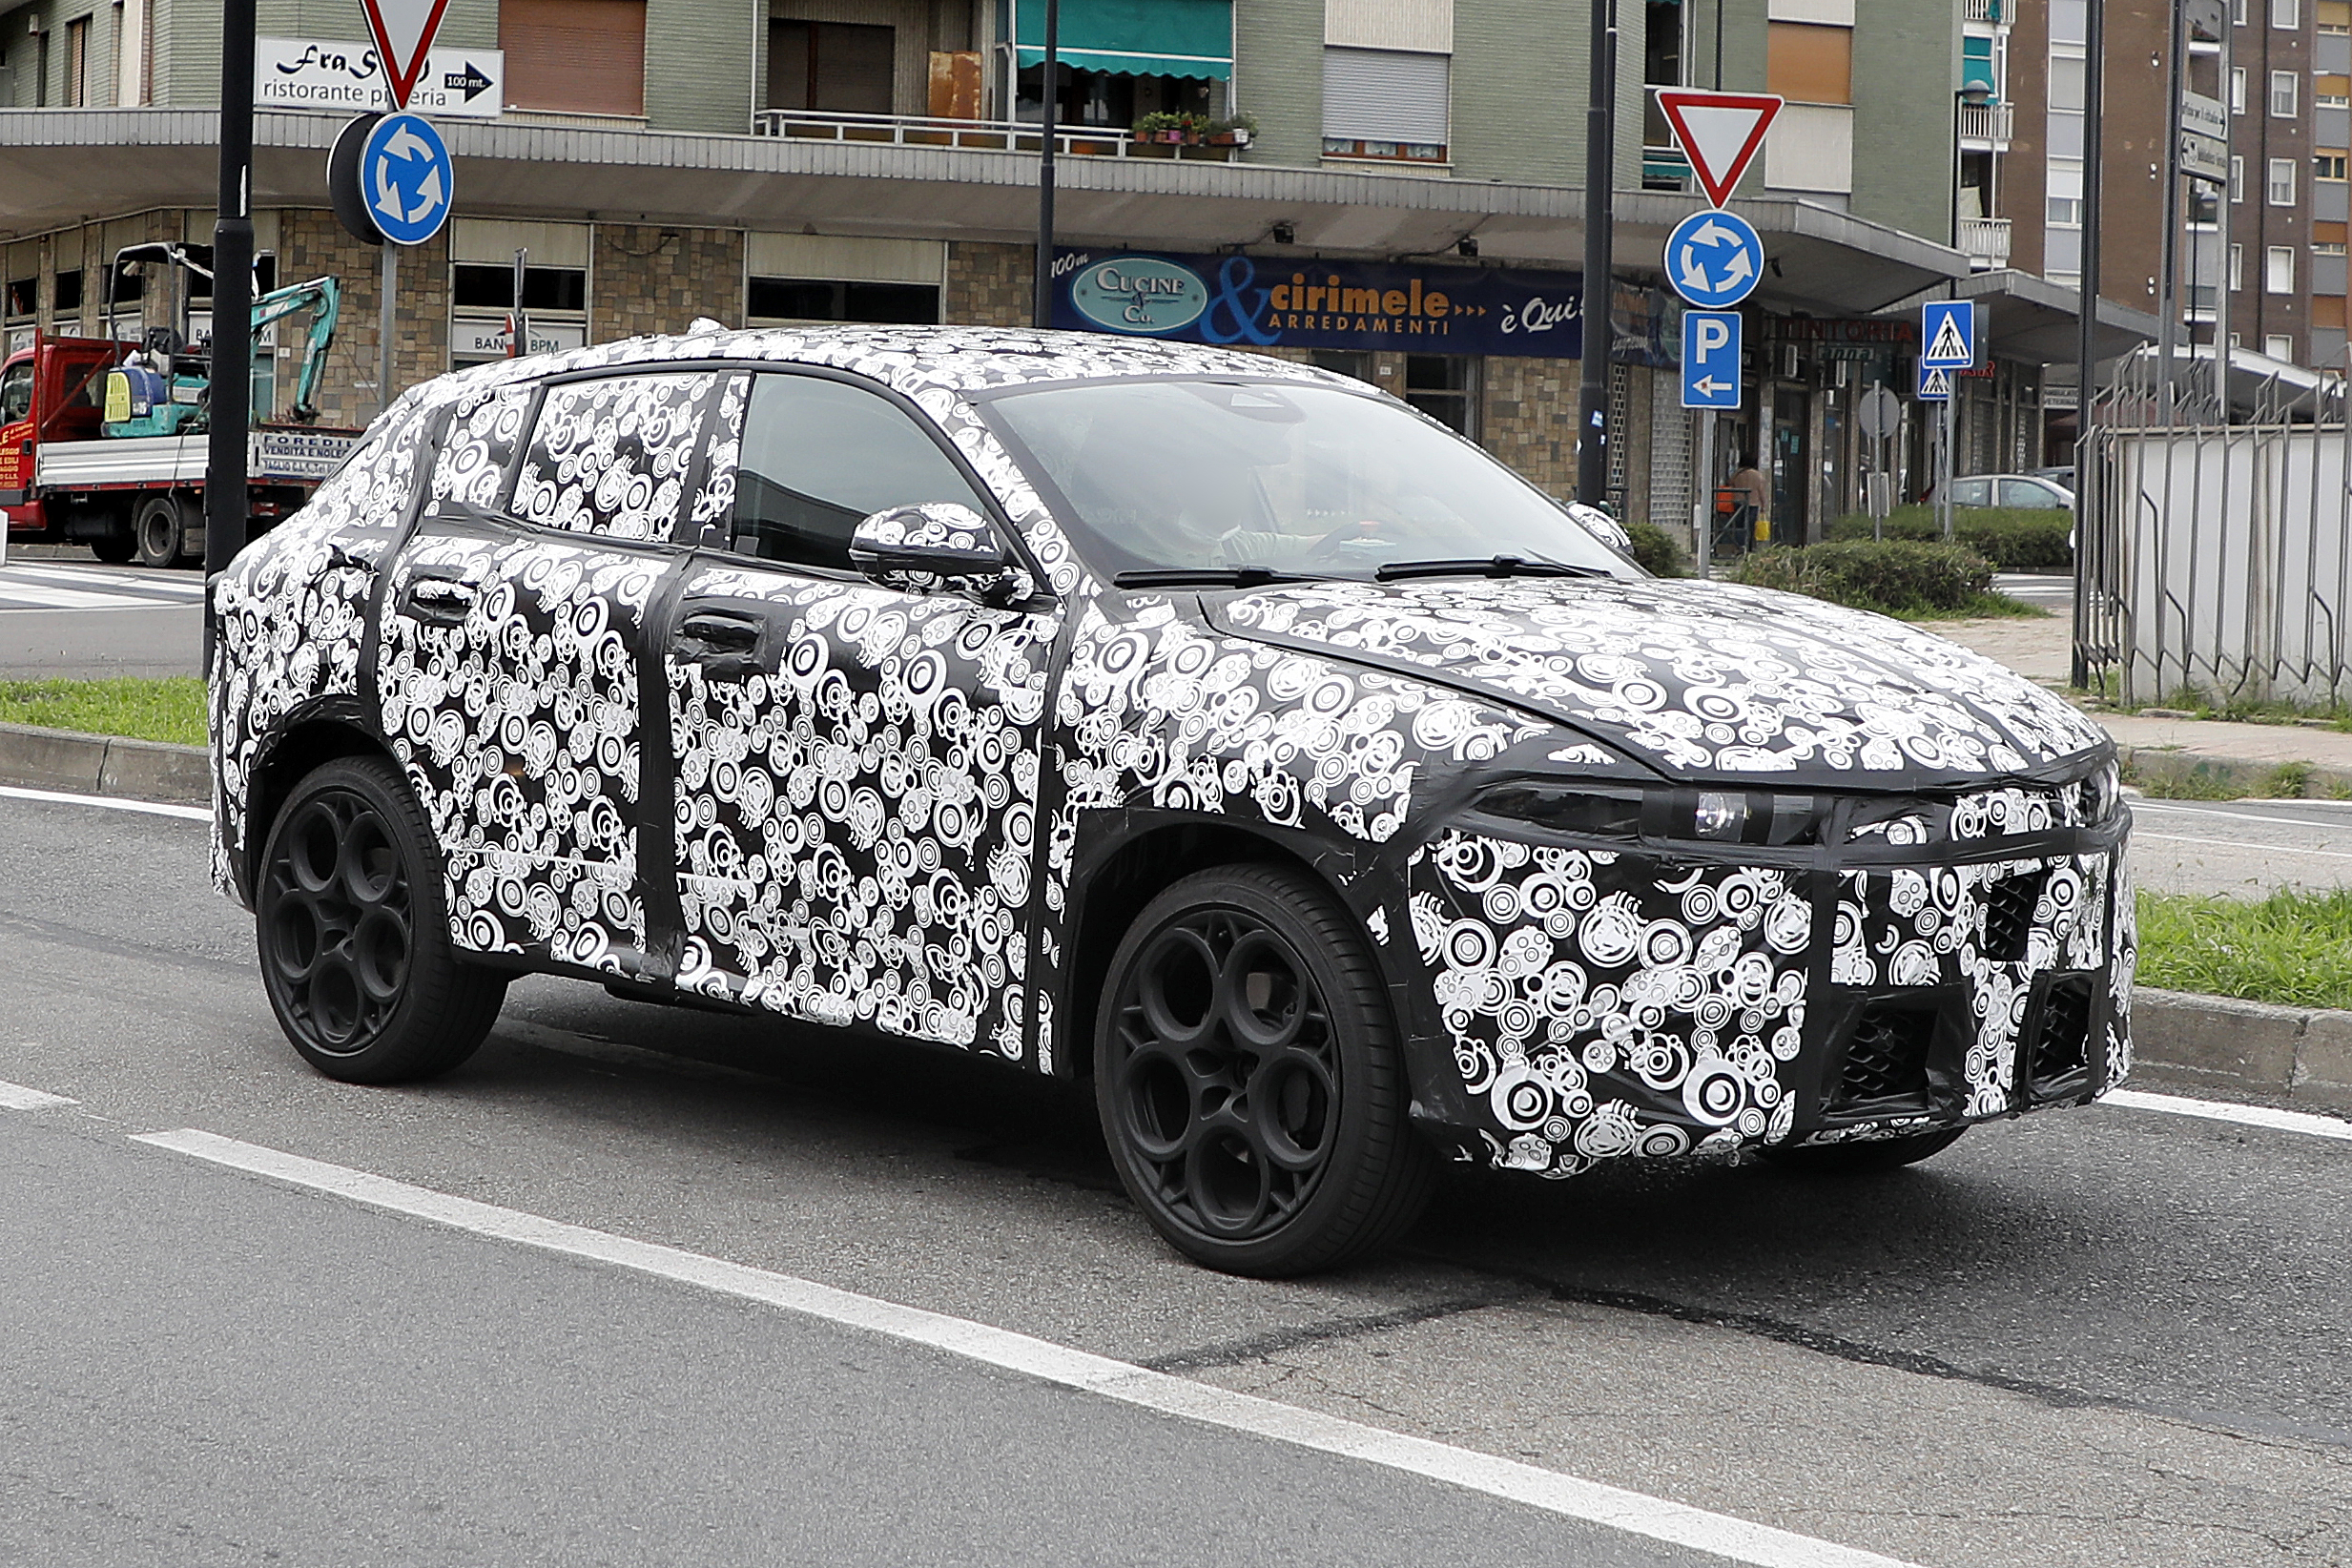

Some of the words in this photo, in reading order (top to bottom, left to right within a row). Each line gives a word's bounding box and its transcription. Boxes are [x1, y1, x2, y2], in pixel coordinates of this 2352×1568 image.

[263, 78, 364, 102] ristorante
[370, 87, 446, 106] pieria
[446, 75, 466, 88] 100
[1269, 272, 1450, 317] cirimele
[1269, 313, 1449, 335] ARREDAMENTI
[1500, 303, 1518, 334] è
[1696, 318, 1729, 364] P
[1781, 320, 1914, 342] TINTORIA
[530, 340, 560, 352] BPM
[265, 445, 305, 456] VENDITA
